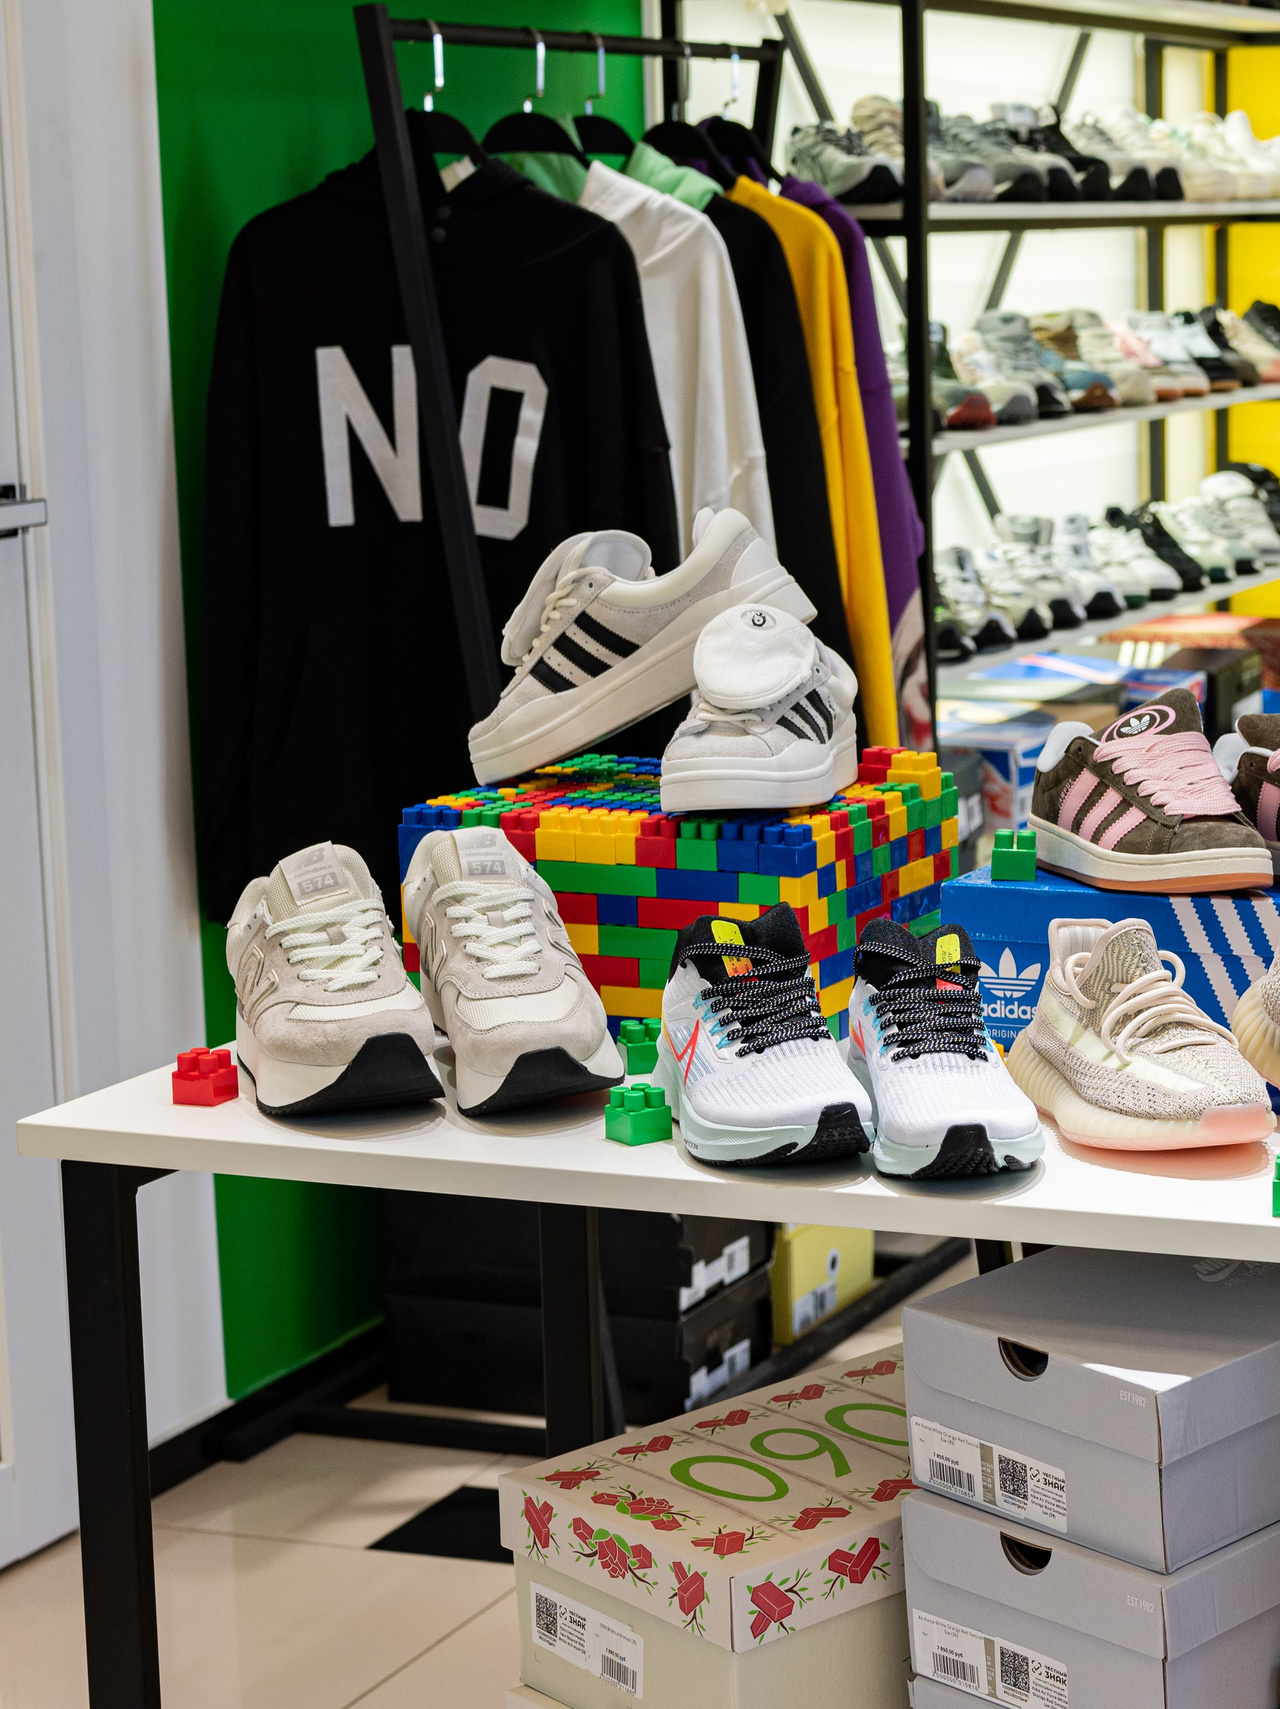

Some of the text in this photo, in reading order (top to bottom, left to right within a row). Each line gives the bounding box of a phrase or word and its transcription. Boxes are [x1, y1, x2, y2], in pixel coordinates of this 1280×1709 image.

[316, 345, 548, 540] NO
[473, 862, 501, 876] 574
[302, 876, 335, 893] 574
[1042, 1471, 1066, 1484] ЧЕСТНЫЙ
[1042, 1477, 1066, 1493] ЗНАК
[569, 1615, 586, 1631] ЗНАК
[1044, 1665, 1068, 1677] ЧЕСТНЫЙ
[1044, 1670, 1067, 1687] ЗНАК
